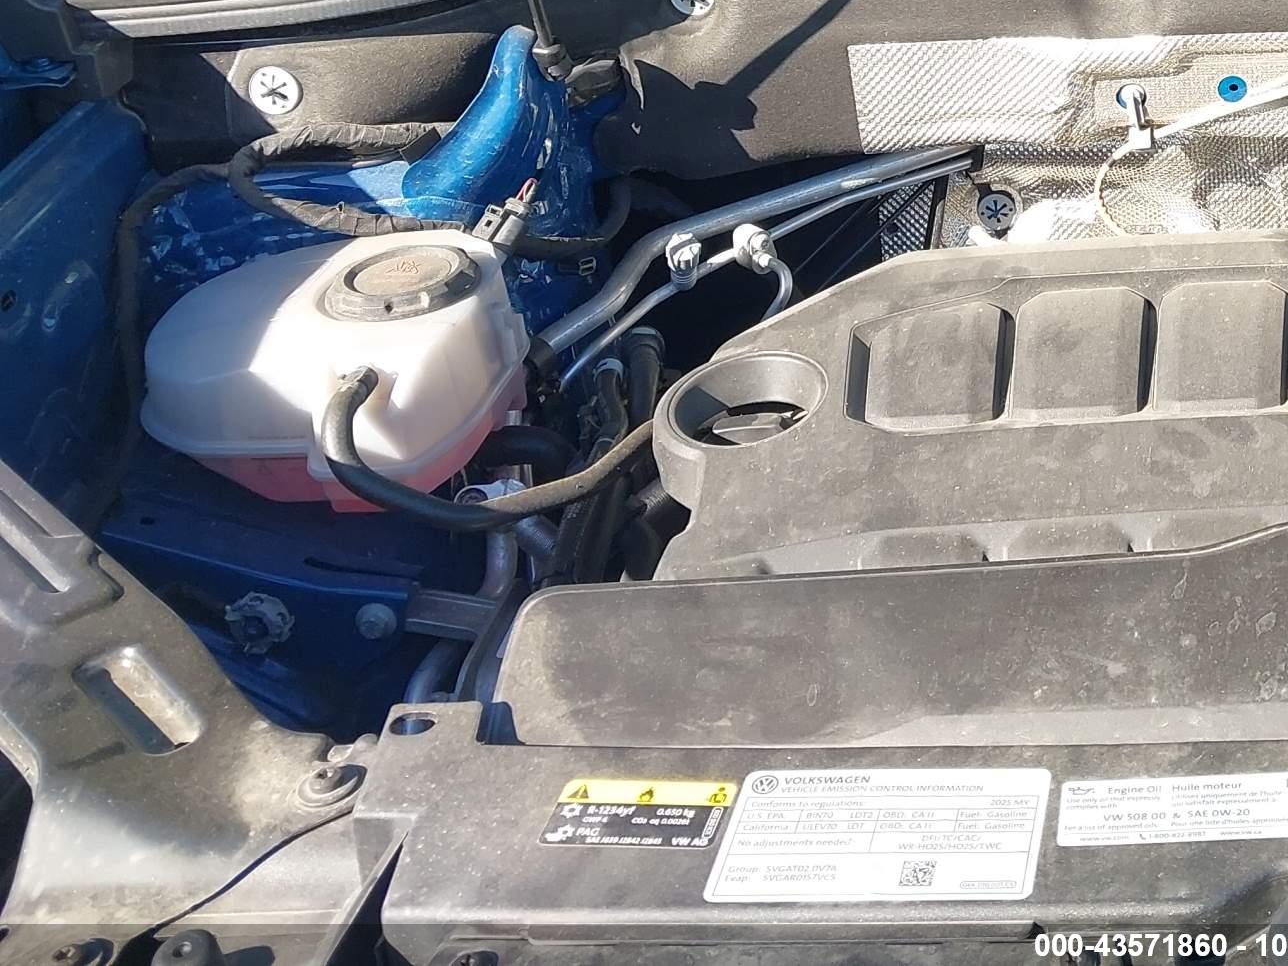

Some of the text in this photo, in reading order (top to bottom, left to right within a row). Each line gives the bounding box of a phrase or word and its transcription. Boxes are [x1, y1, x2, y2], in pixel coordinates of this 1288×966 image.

[783, 776, 871, 785] VOLKSWAGEN
[781, 786, 818, 794] VEHICLE
[821, 785, 867, 793] EMISSION
[1108, 785, 1162, 795] Engine Oil
[1172, 782, 1242, 792] Huile moteur
[751, 801, 797, 809] Conforms
[586, 805, 637, 817] R-1234yf
[683, 807, 697, 818] kg
[986, 811, 1028, 819] Gasoline
[1103, 813, 1124, 822] VW
[1127, 812, 1148, 821] 508
[1151, 812, 1167, 820] 00
[1187, 809, 1209, 818] SAE
[1211, 808, 1251, 817] 0W-20
[984, 822, 1026, 830] Gasoline
[576, 827, 601, 836] PAG
[671, 837, 691, 846] VW
[691, 837, 709, 847] AG
[753, 838, 814, 847] adjustments
